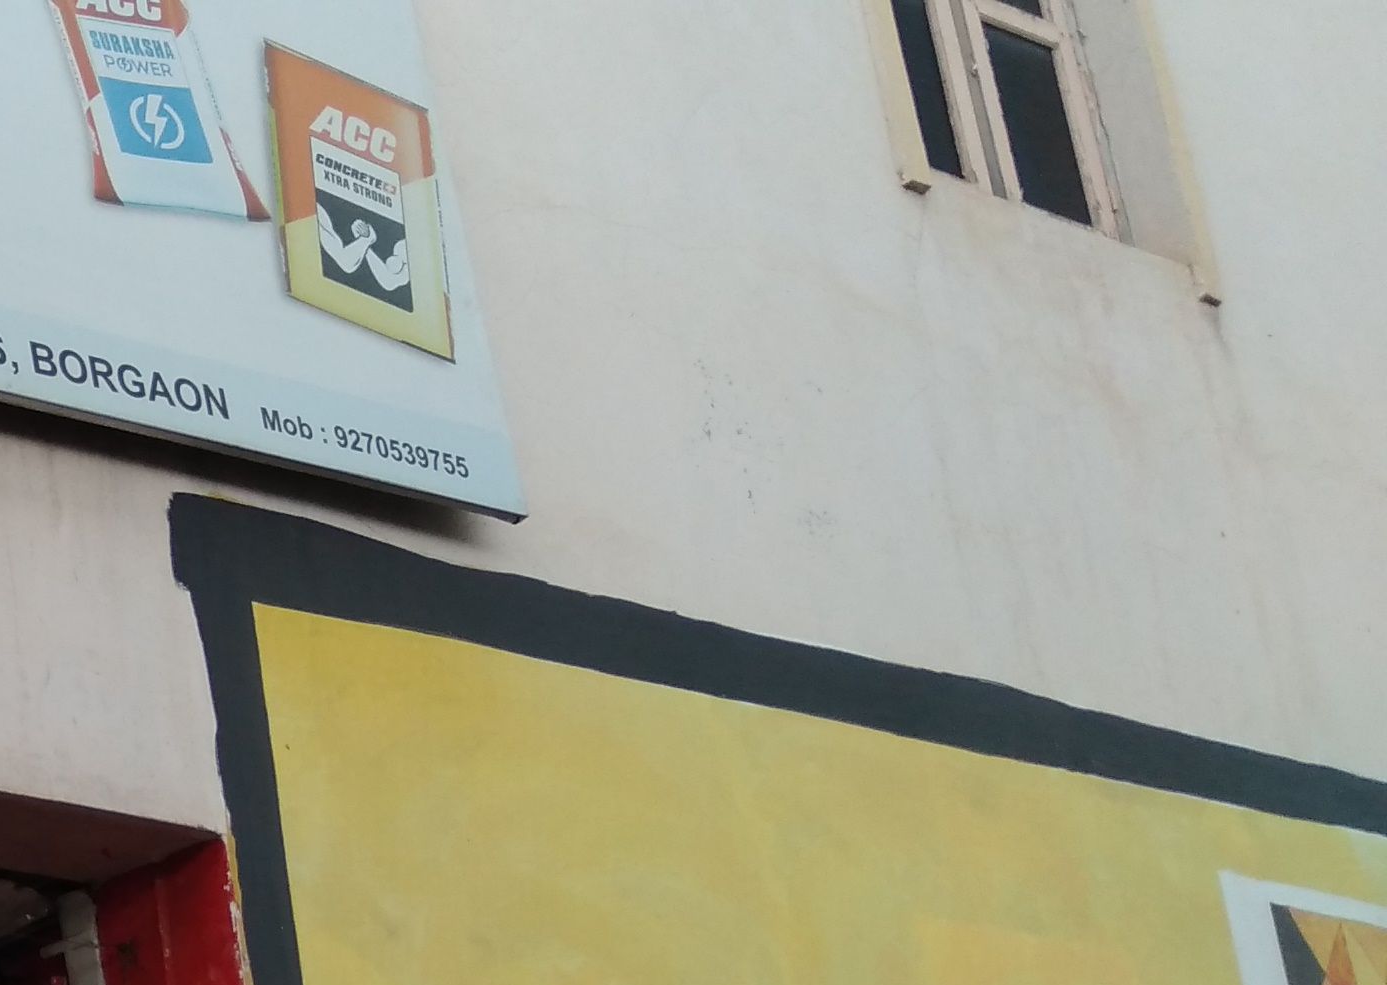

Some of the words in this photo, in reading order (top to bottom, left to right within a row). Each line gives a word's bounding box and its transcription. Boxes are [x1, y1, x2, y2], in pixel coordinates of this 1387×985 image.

[89, 30, 174, 59] SURAKSHA
[308, 105, 396, 163] ACC
[323, 169, 351, 191] XTRA
[352, 182, 393, 208] STRONG
[29, 341, 230, 420] BORGAON
[334, 425, 470, 479] 9270539755
